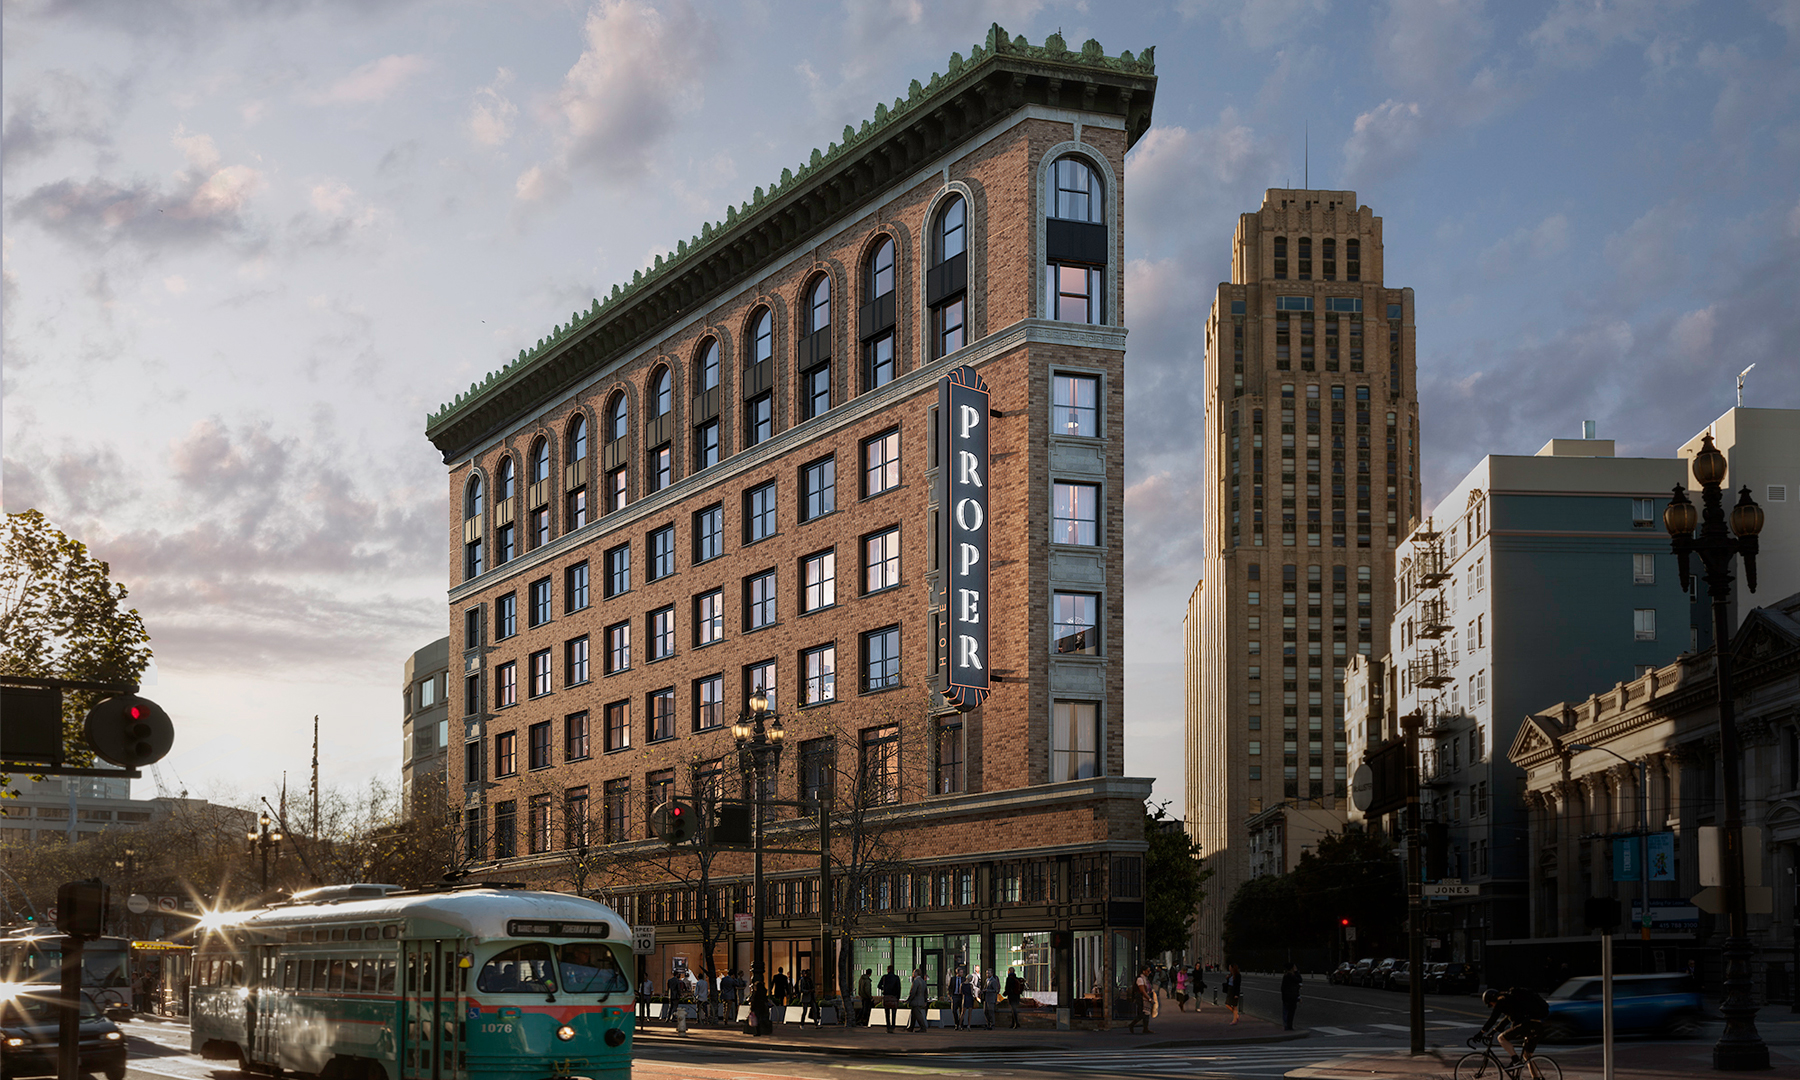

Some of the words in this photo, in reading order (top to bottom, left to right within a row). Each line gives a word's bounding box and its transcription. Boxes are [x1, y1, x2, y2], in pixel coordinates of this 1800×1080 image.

[956, 404, 984, 671] PROPER
[939, 586, 947, 667] HOTEL
[1435, 886, 1470, 894] JONES
[511, 922, 517, 933] F
[637, 939, 651, 949] 10
[481, 1023, 513, 1034] 1076
